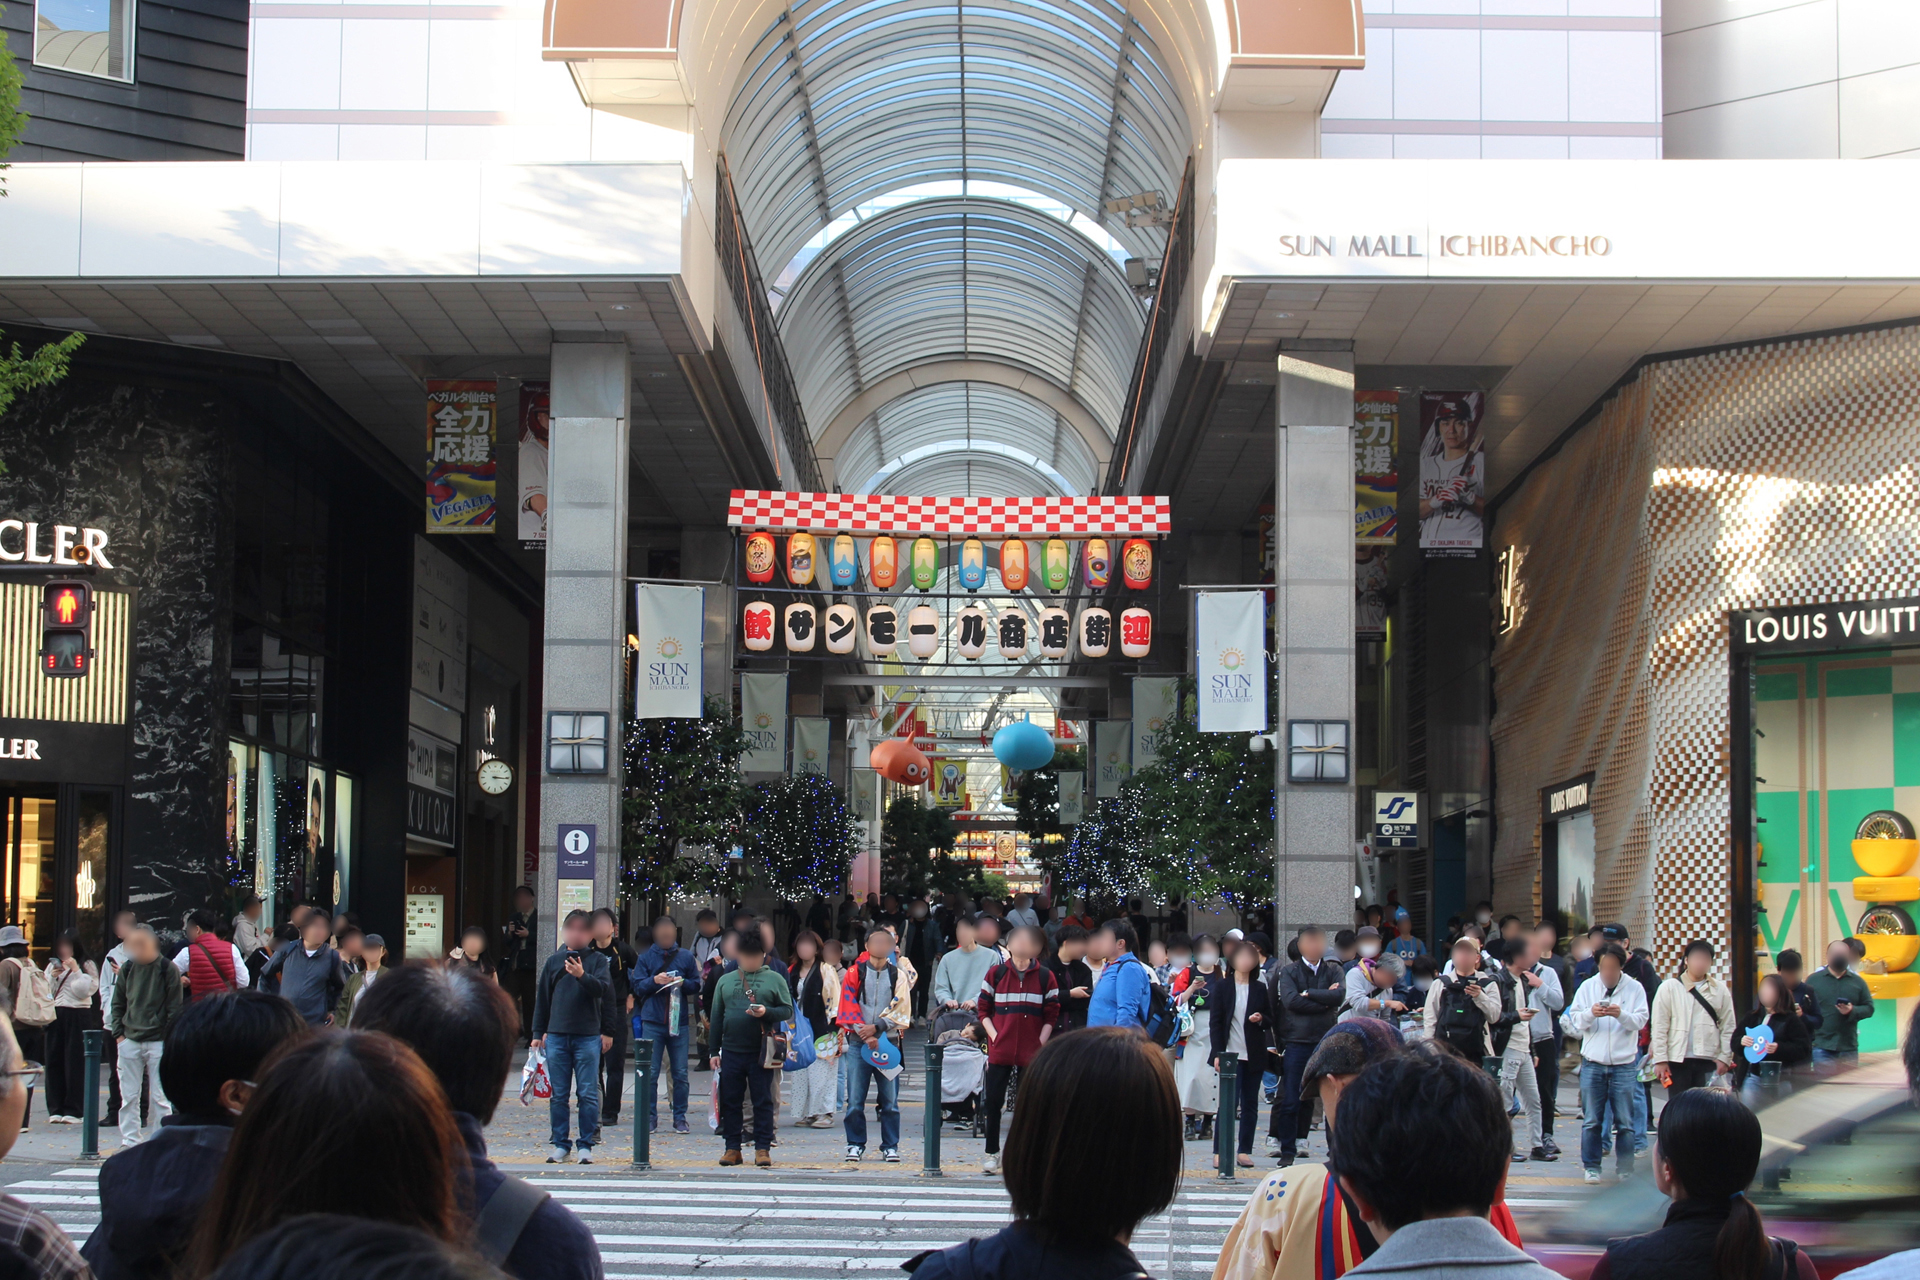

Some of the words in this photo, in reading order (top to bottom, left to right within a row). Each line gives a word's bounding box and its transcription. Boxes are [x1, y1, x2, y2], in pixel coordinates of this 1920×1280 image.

[1279, 235, 1333, 257] SUN
[1348, 235, 1424, 257] MALL
[1439, 235, 1611, 257] ICHIBANCHO
[428, 391, 496, 404] ベガルタ仙台を
[434, 405, 490, 433] 全力
[433, 434, 490, 463] 応援
[430, 494, 496, 523] VEGALTA
[0, 519, 114, 569] CLER
[1745, 612, 1828, 644] LOUIS
[1837, 605, 1920, 637] VUITT
[649, 662, 690, 676] SUN
[649, 676, 689, 686] MALL
[1212, 674, 1252, 688] SUN
[1212, 689, 1253, 698] MALL
[749, 731, 777, 742] SUN
[416, 745, 434, 778] HIDA
[799, 762, 821, 771] SUN
[1550, 790, 1565, 814] LOUIS
[1565, 783, 1588, 810] VUITTON
